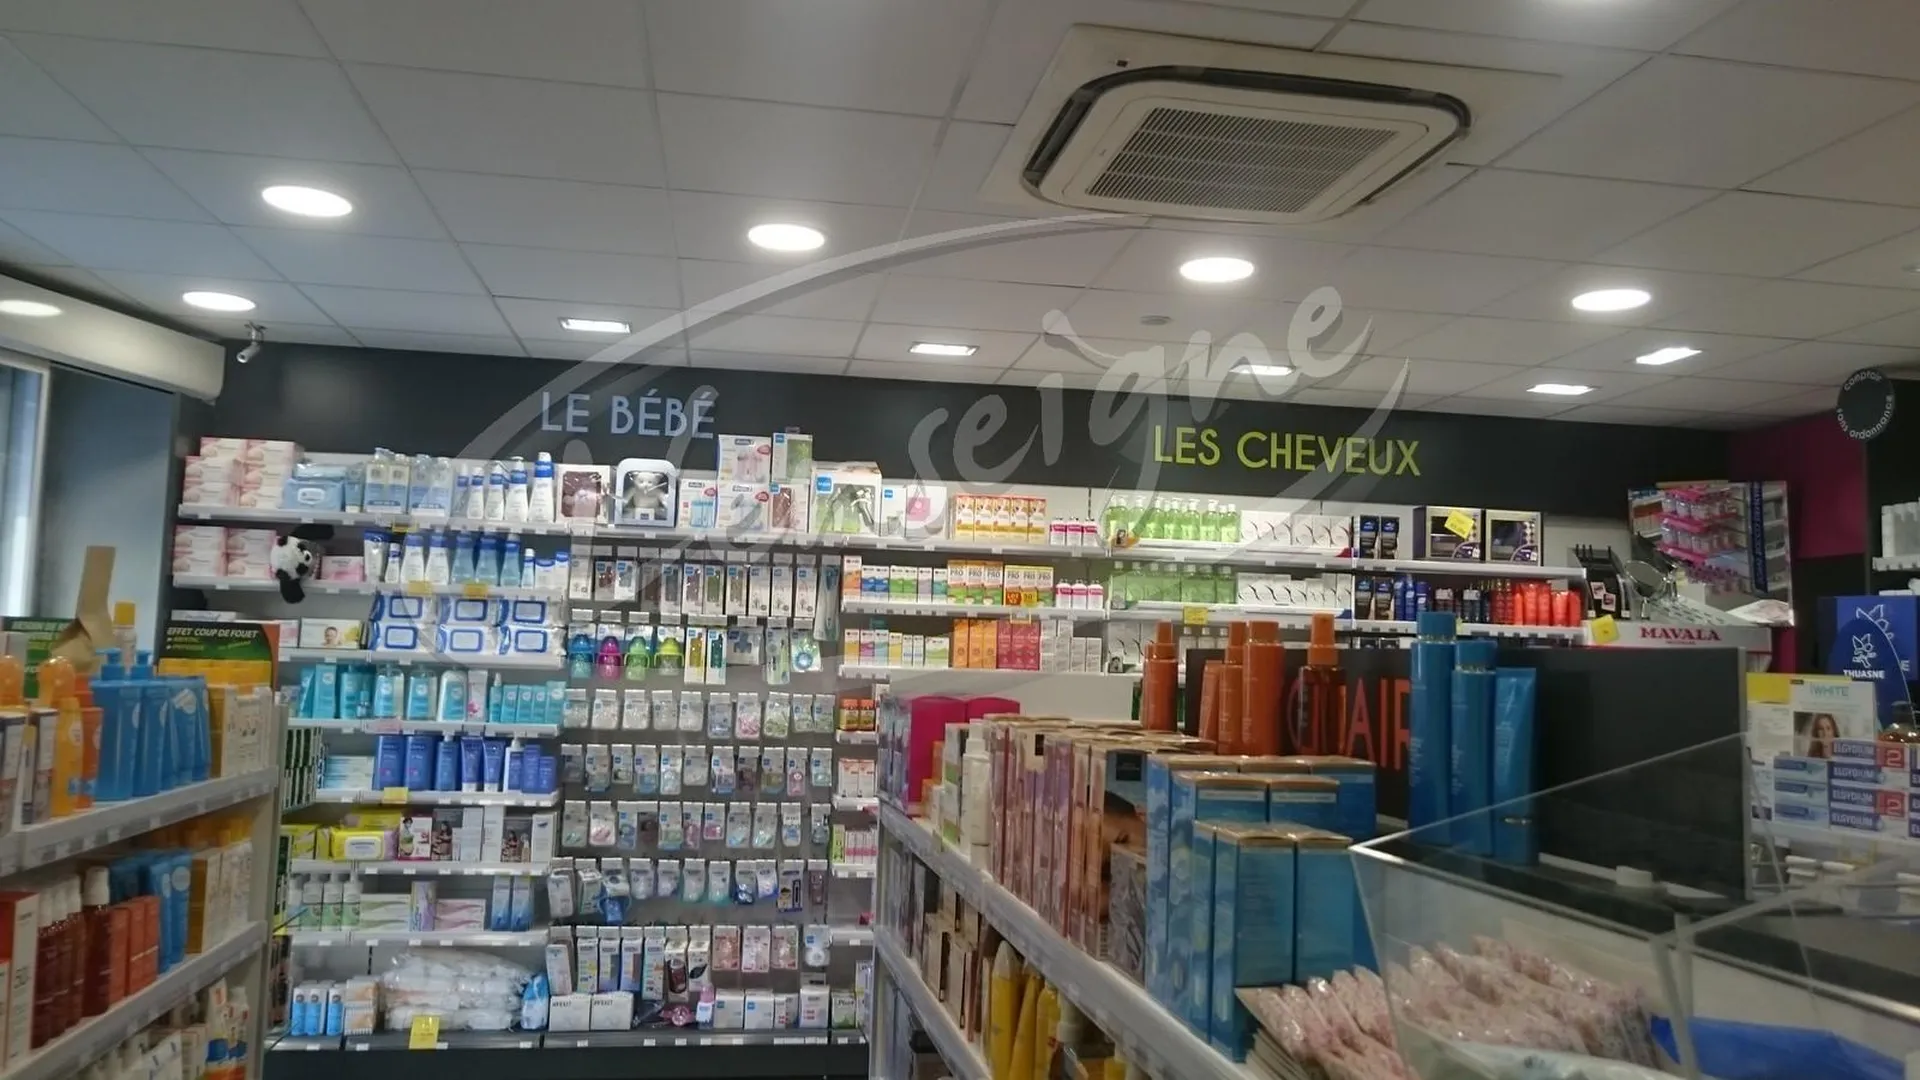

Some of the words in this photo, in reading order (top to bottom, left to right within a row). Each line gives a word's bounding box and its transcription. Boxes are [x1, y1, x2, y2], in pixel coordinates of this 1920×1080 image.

[541, 391, 591, 433] LE
[610, 388, 715, 439] BÉBÉ
[1154, 424, 1221, 467] LES
[1236, 430, 1422, 477] CHEVEUX
[166, 627, 193, 636] EFFET
[193, 627, 217, 637] COUP
[217, 628, 231, 637] DE
[230, 629, 259, 639] FOUET
[1640, 627, 1721, 641] MAVALA
[1843, 669, 1885, 679] THUASNE
